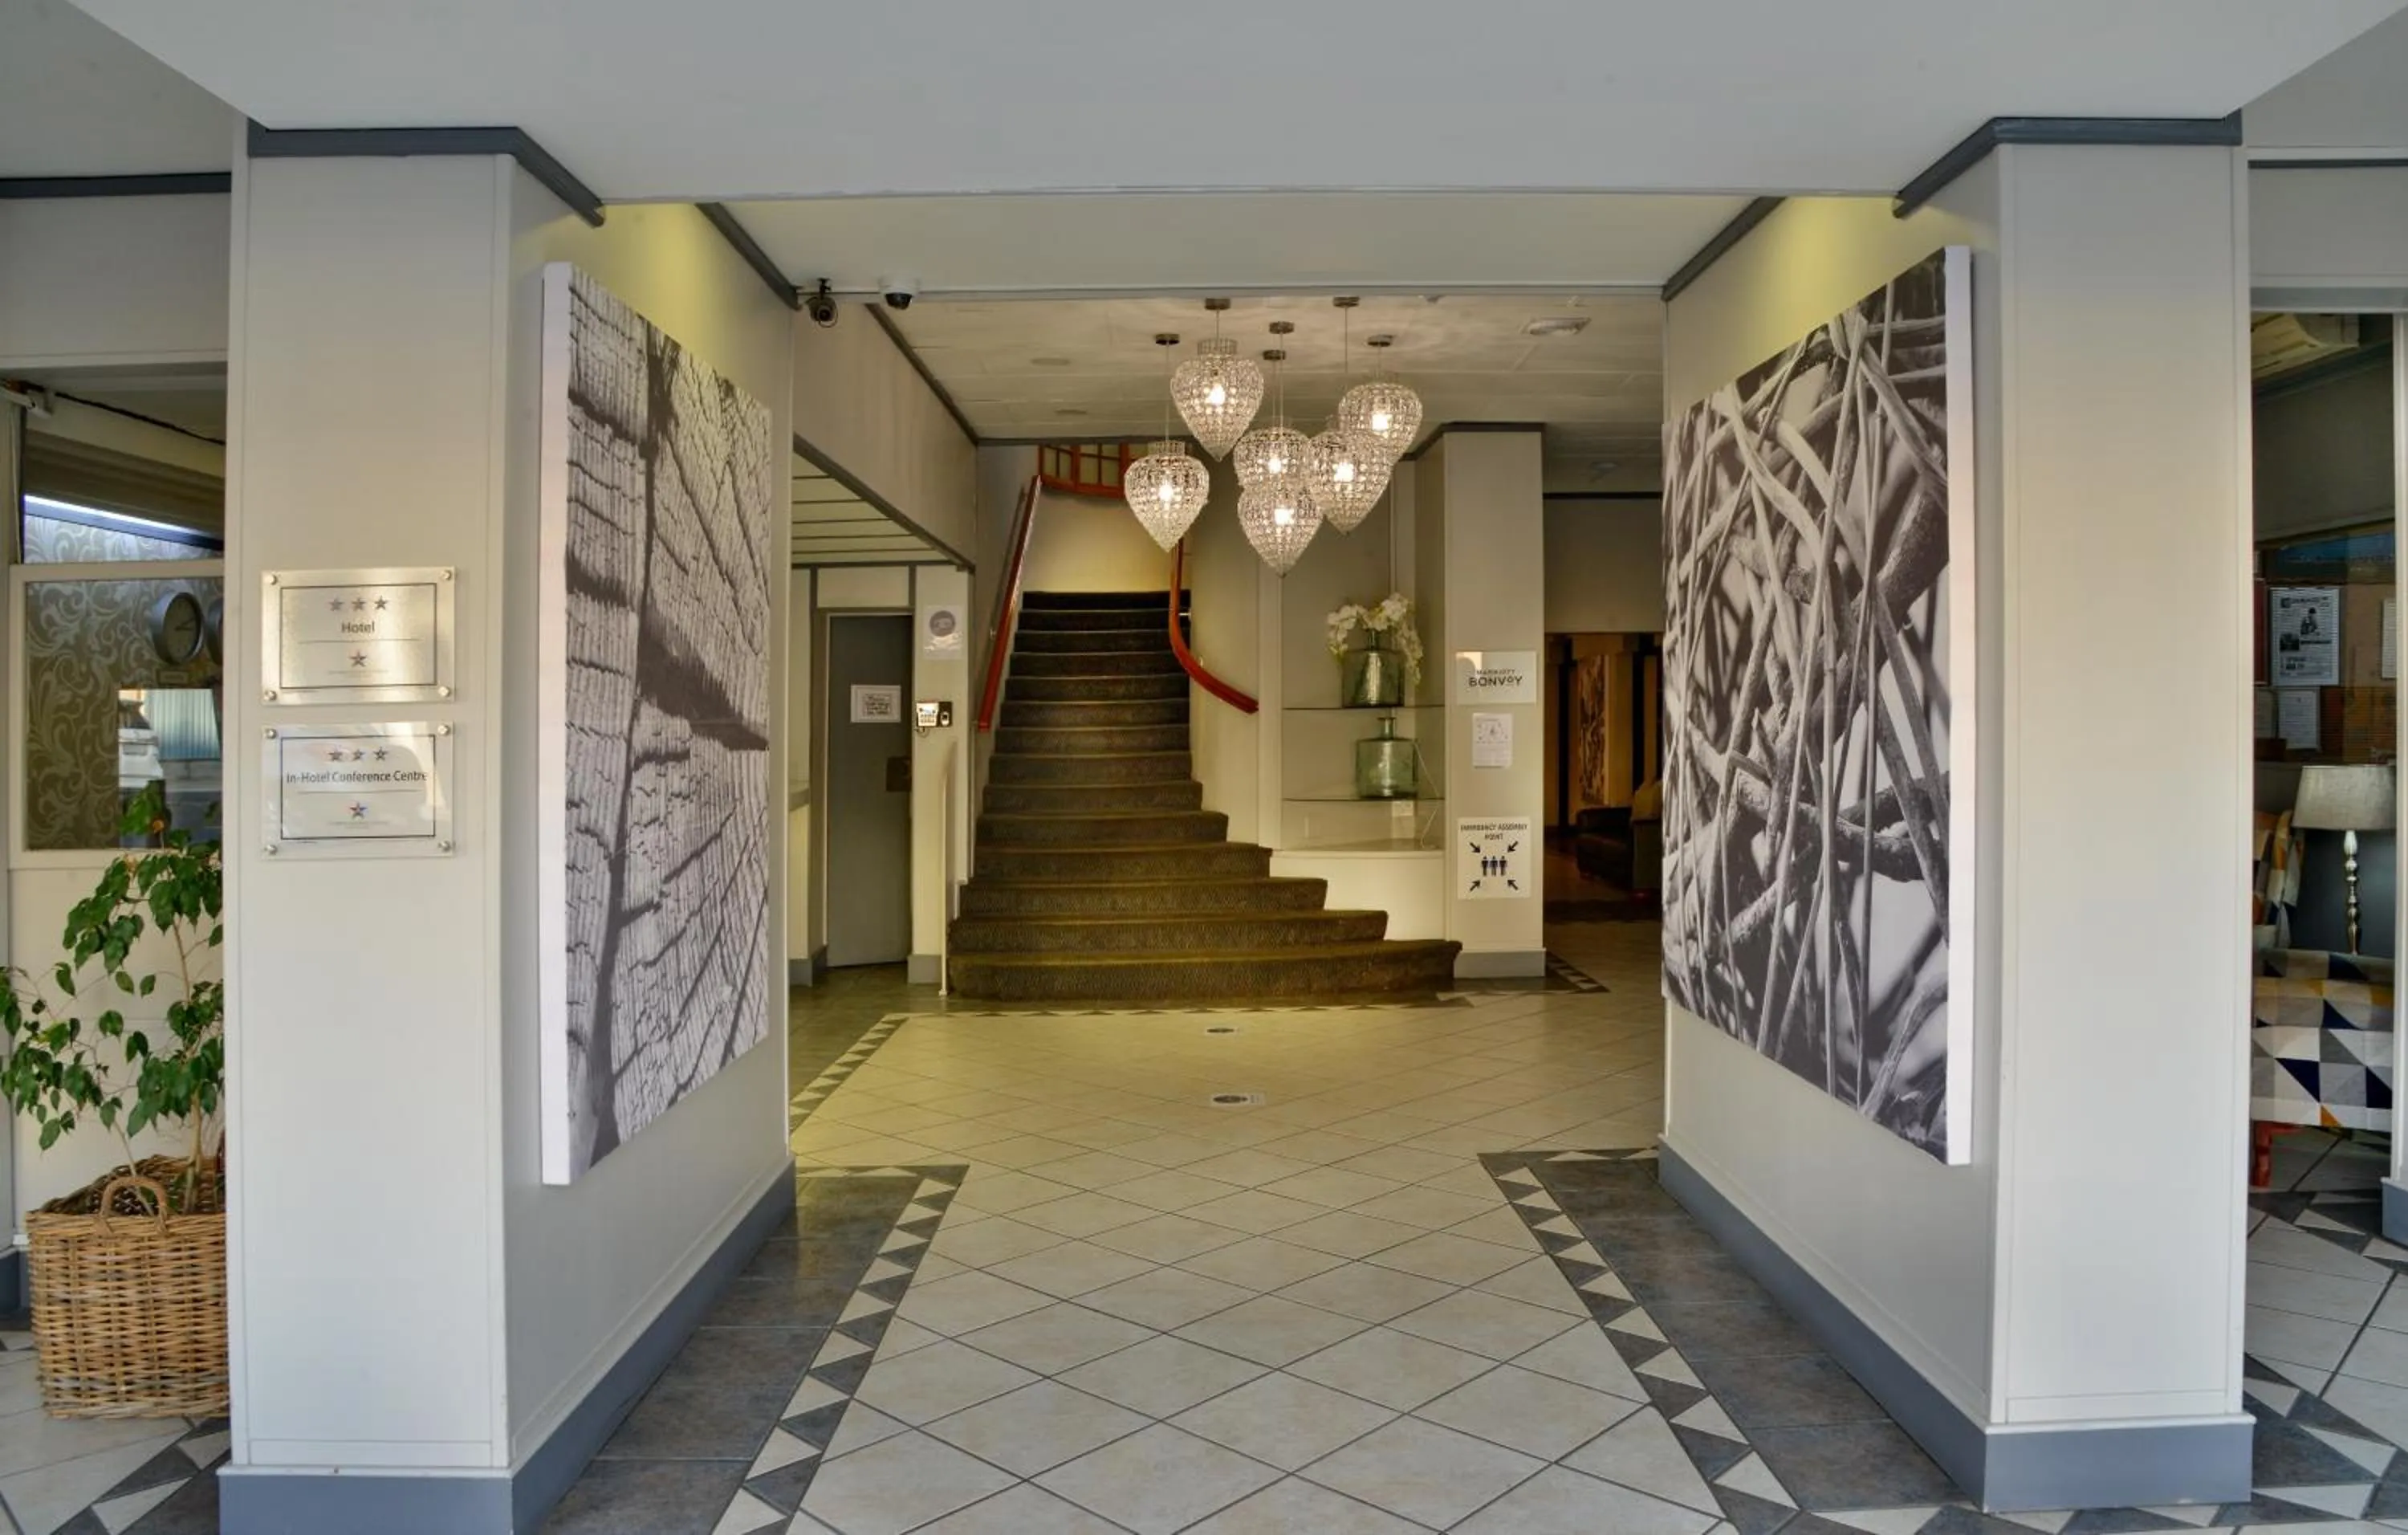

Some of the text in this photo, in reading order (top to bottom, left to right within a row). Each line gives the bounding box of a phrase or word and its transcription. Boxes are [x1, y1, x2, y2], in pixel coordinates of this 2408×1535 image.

[341, 621, 375, 633] Hotel
[287, 772, 330, 784] In-Hotel
[332, 772, 391, 783] Conference
